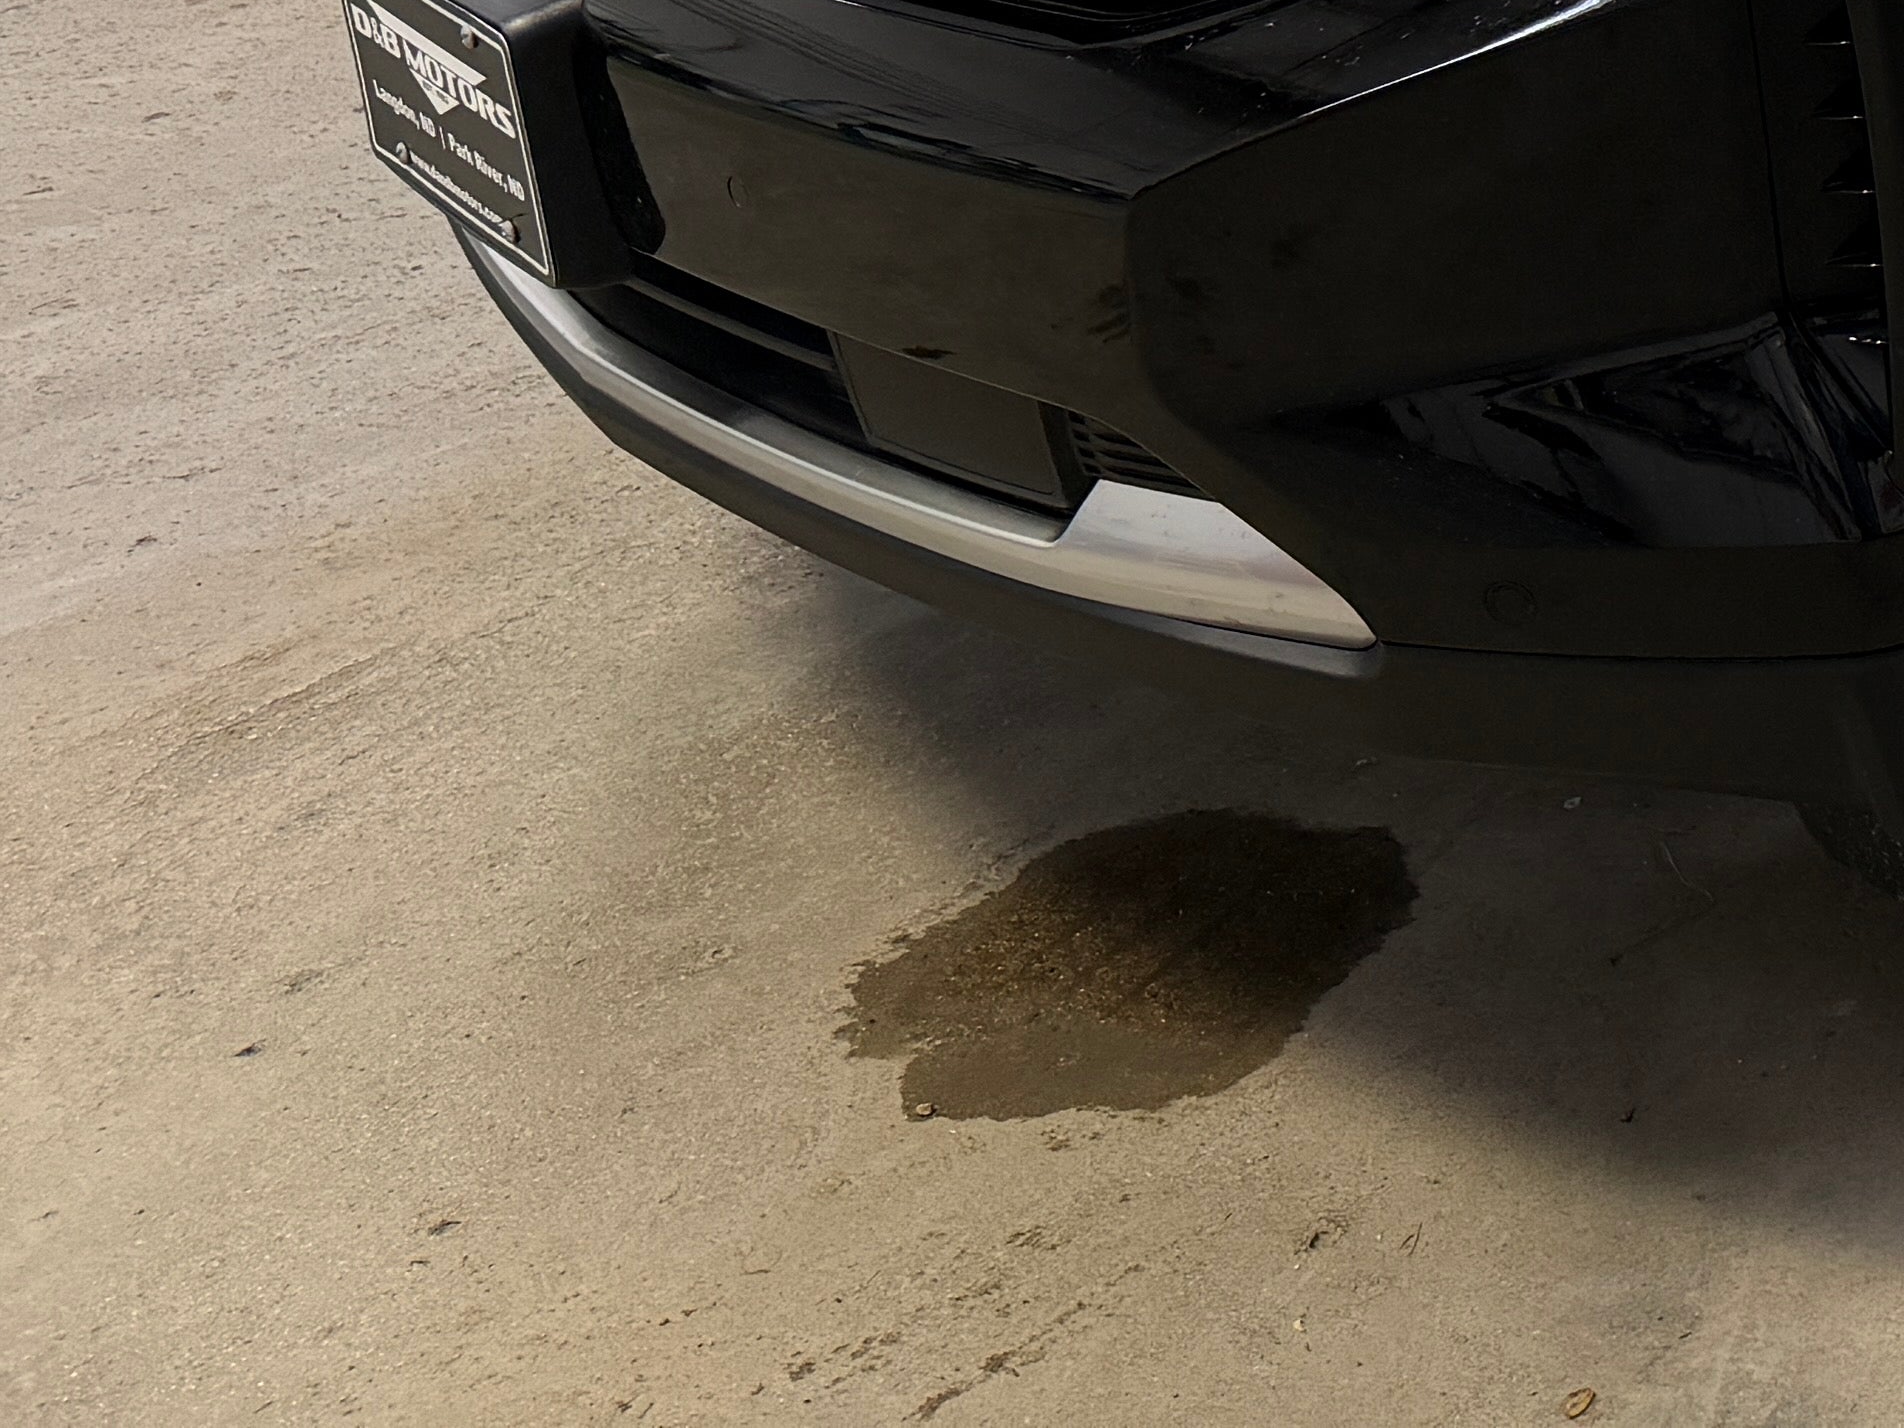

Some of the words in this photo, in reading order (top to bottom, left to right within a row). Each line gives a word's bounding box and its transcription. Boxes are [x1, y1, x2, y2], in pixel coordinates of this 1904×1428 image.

[351, 3, 402, 59] D&B
[402, 39, 517, 139] MOTORS
[448, 133, 474, 166] Park
